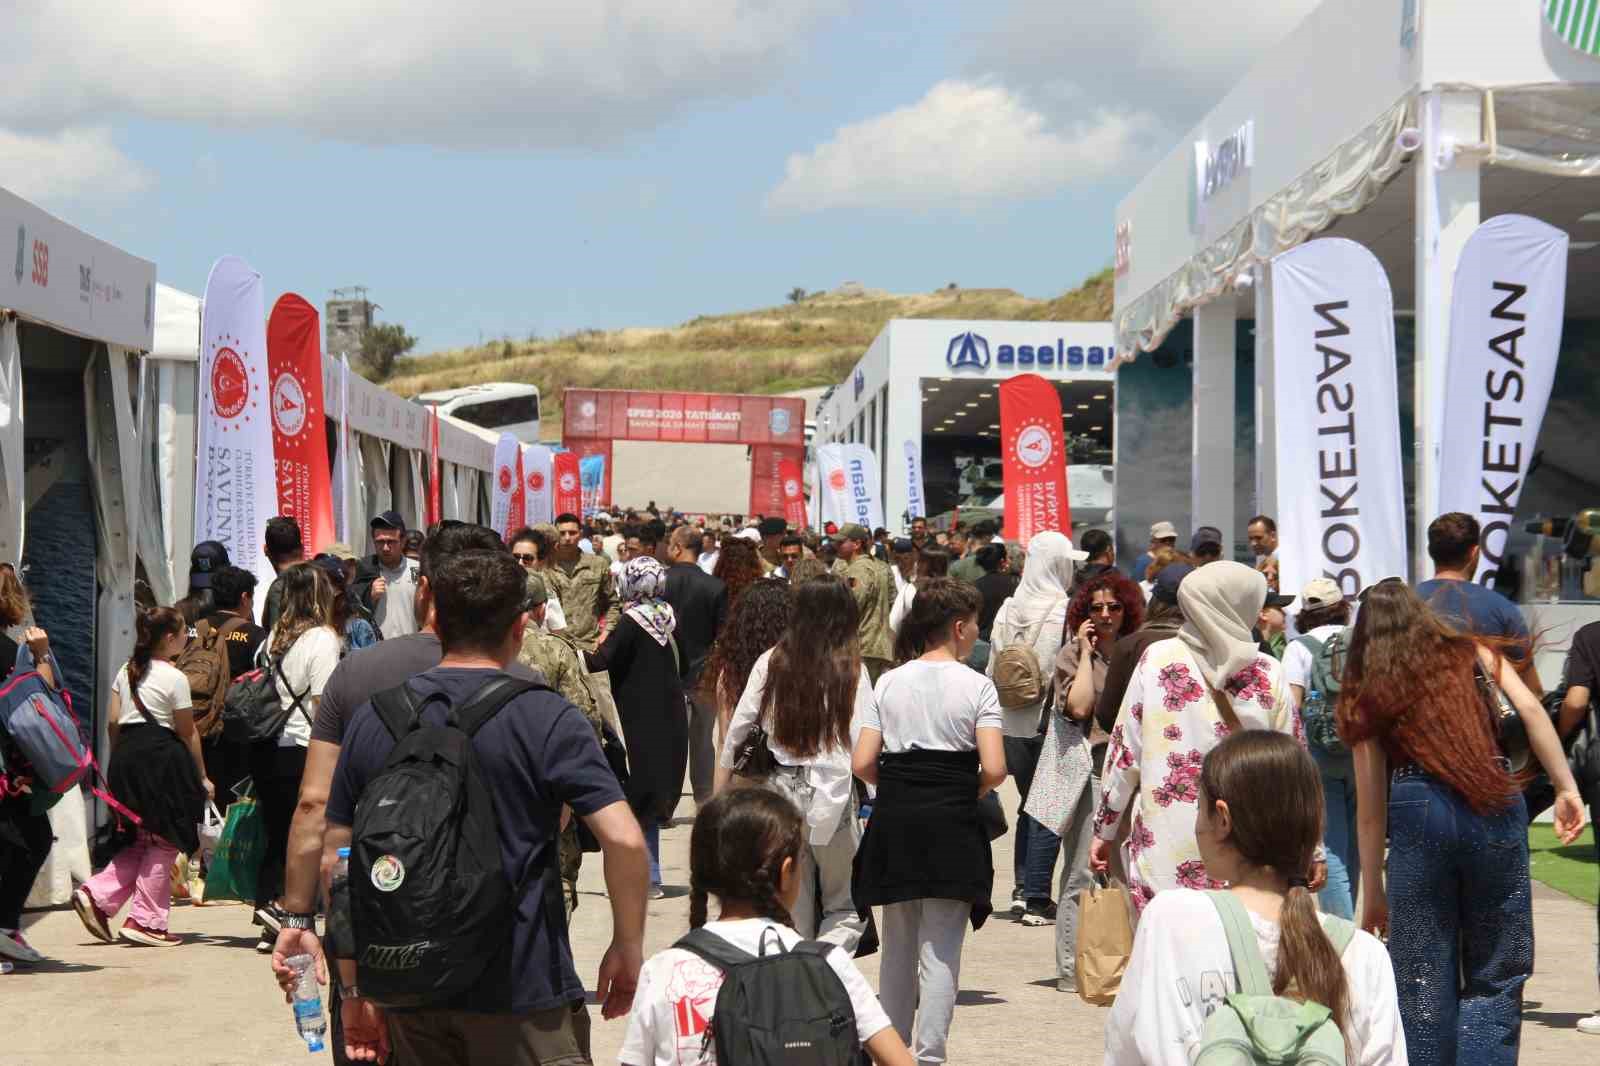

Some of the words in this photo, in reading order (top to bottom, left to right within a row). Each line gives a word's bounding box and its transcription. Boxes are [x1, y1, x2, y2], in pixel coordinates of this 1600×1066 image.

[32, 239, 49, 288] SSB
[281, 459, 294, 517] SAVU
[360, 940, 430, 970] NIKE
